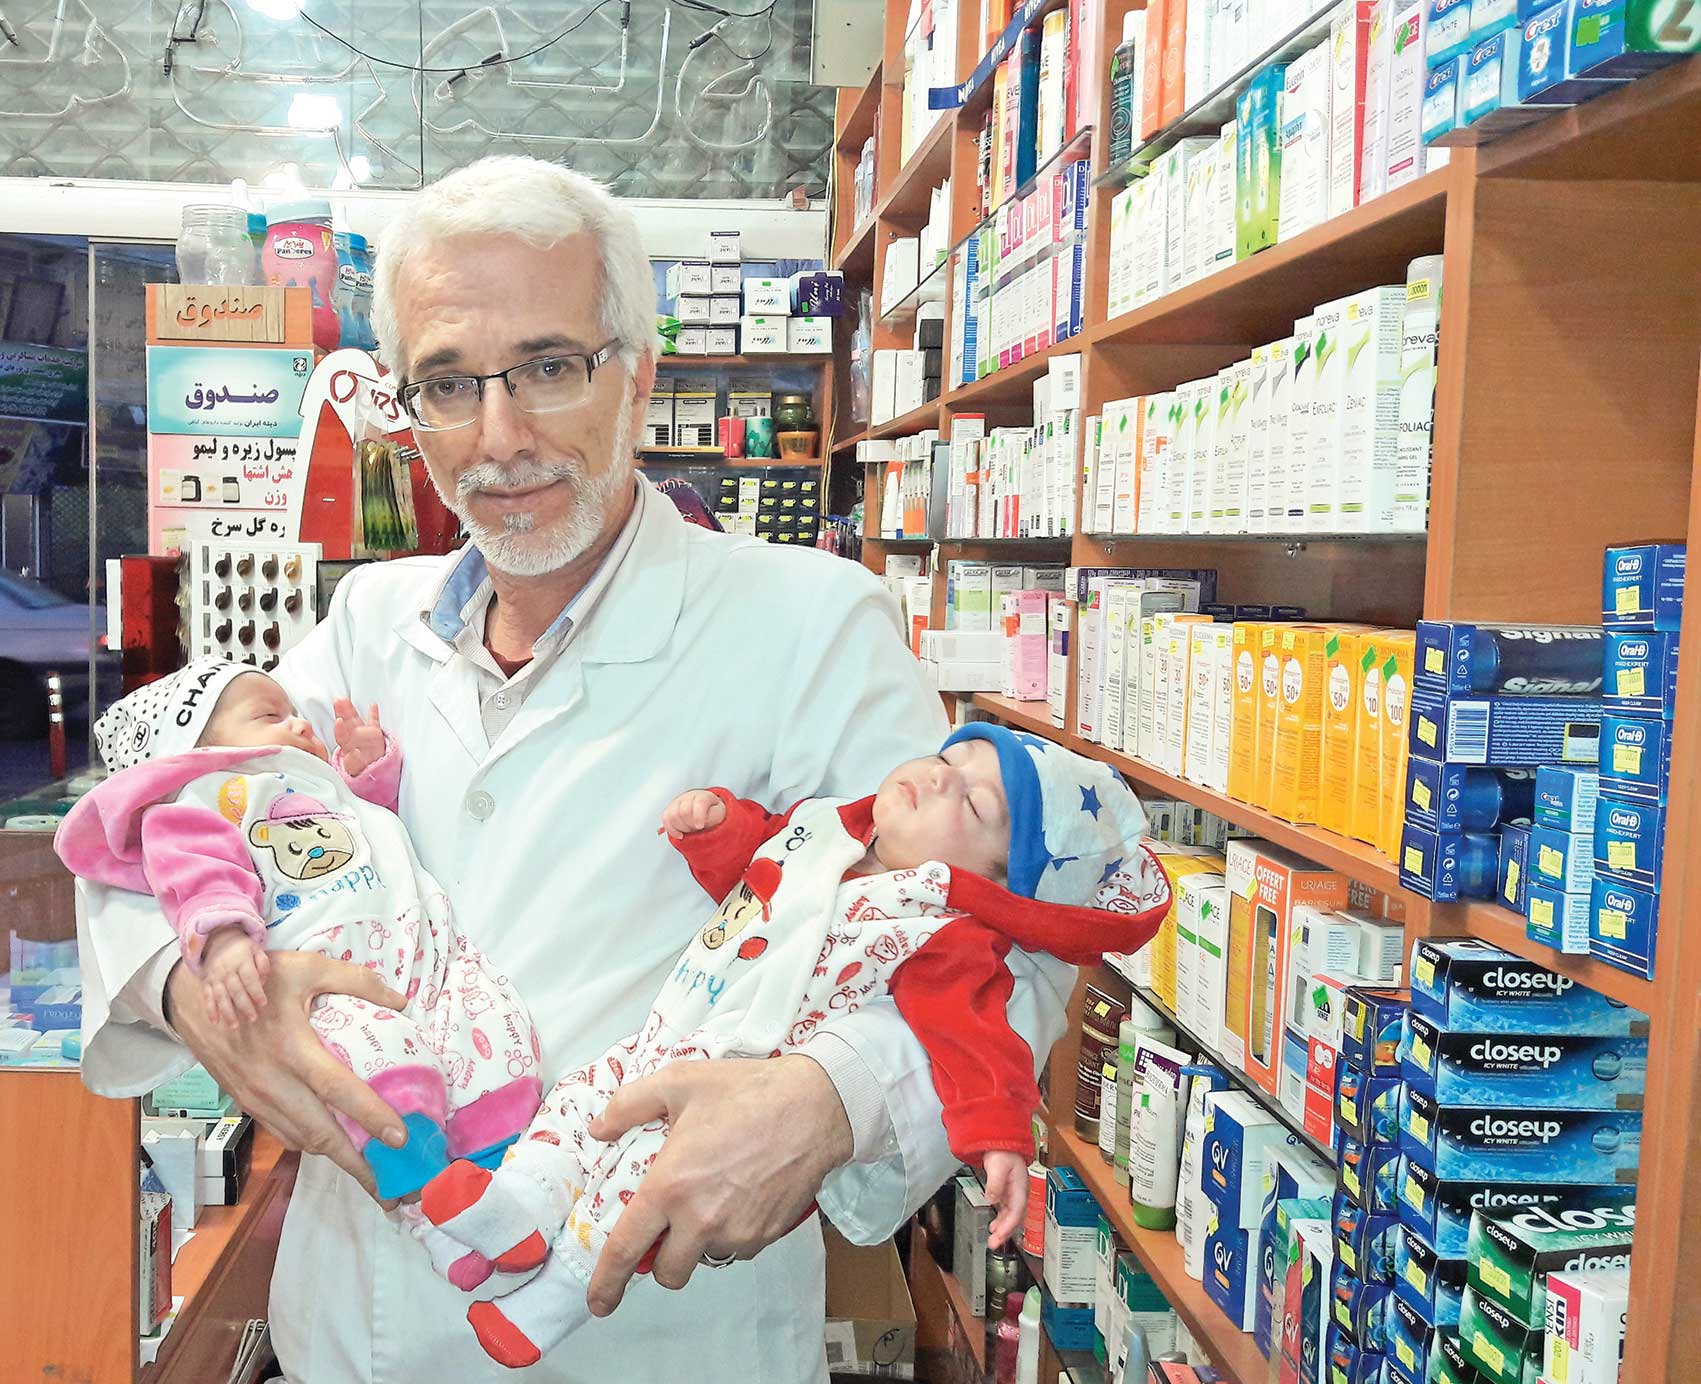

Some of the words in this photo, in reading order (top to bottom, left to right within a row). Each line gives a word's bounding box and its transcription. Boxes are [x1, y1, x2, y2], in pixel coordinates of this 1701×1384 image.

[1525, 8, 1562, 42] Crest
[175, 295, 264, 329] صندوق
[1316, 311, 1341, 327] noreva
[185, 382, 280, 410] صندوق
[244, 419, 262, 429] ایران
[262, 420, 278, 429] دینه
[192, 437, 217, 460] لیمو
[222, 444, 229, 460] و
[231, 442, 261, 462] زیره
[243, 464, 269, 482] اشتها
[264, 489, 288, 506] وزن
[211, 516, 242, 538] سرخ
[246, 516, 266, 536] گل
[1619, 643, 1648, 659] Oral-B
[1239, 674, 1251, 690] 50+
[1265, 679, 1277, 694] 50+
[1286, 684, 1299, 701] 50+
[1332, 691, 1347, 708] 50+
[1368, 697, 1379, 713] 10
[1390, 705, 1404, 722] 100
[1618, 728, 1644, 743] Oral-B
[1612, 813, 1638, 829] Oral-B
[1256, 864, 1284, 891] OFFERT
[1300, 879, 1337, 891] URIAGE
[1258, 881, 1279, 906] FREE
[1607, 896, 1634, 911] Oral-B
[1421, 945, 1441, 966] closeup
[1482, 967, 1574, 996] closeup
[1495, 990, 1508, 998] ICY
[1509, 989, 1531, 998] WHITE
[1410, 1017, 1430, 1038] closeup
[1469, 1039, 1562, 1068] closeup
[1482, 1062, 1496, 1070] ICY
[1496, 1062, 1519, 1070] WHITE
[1409, 1088, 1428, 1110] closeup
[1469, 1114, 1561, 1144] closeup
[1482, 1137, 1496, 1145] ICY
[1496, 1137, 1519, 1145] WHITE
[1211, 1140, 1230, 1171] QV
[1409, 1160, 1428, 1183] closeup
[1486, 1224, 1518, 1252] closeup
[1602, 1230, 1634, 1241] WHI
[1214, 1241, 1233, 1272] QV
[1406, 1235, 1426, 1259] closeup
[1397, 1302, 1417, 1327] closeup
[1479, 1299, 1510, 1330] closeup
[1545, 1297, 1555, 1335] SENSI
[1284, 1311, 1299, 1344] QV
[1301, 1336, 1316, 1364] QV
[1443, 1342, 1465, 1369] closeup
